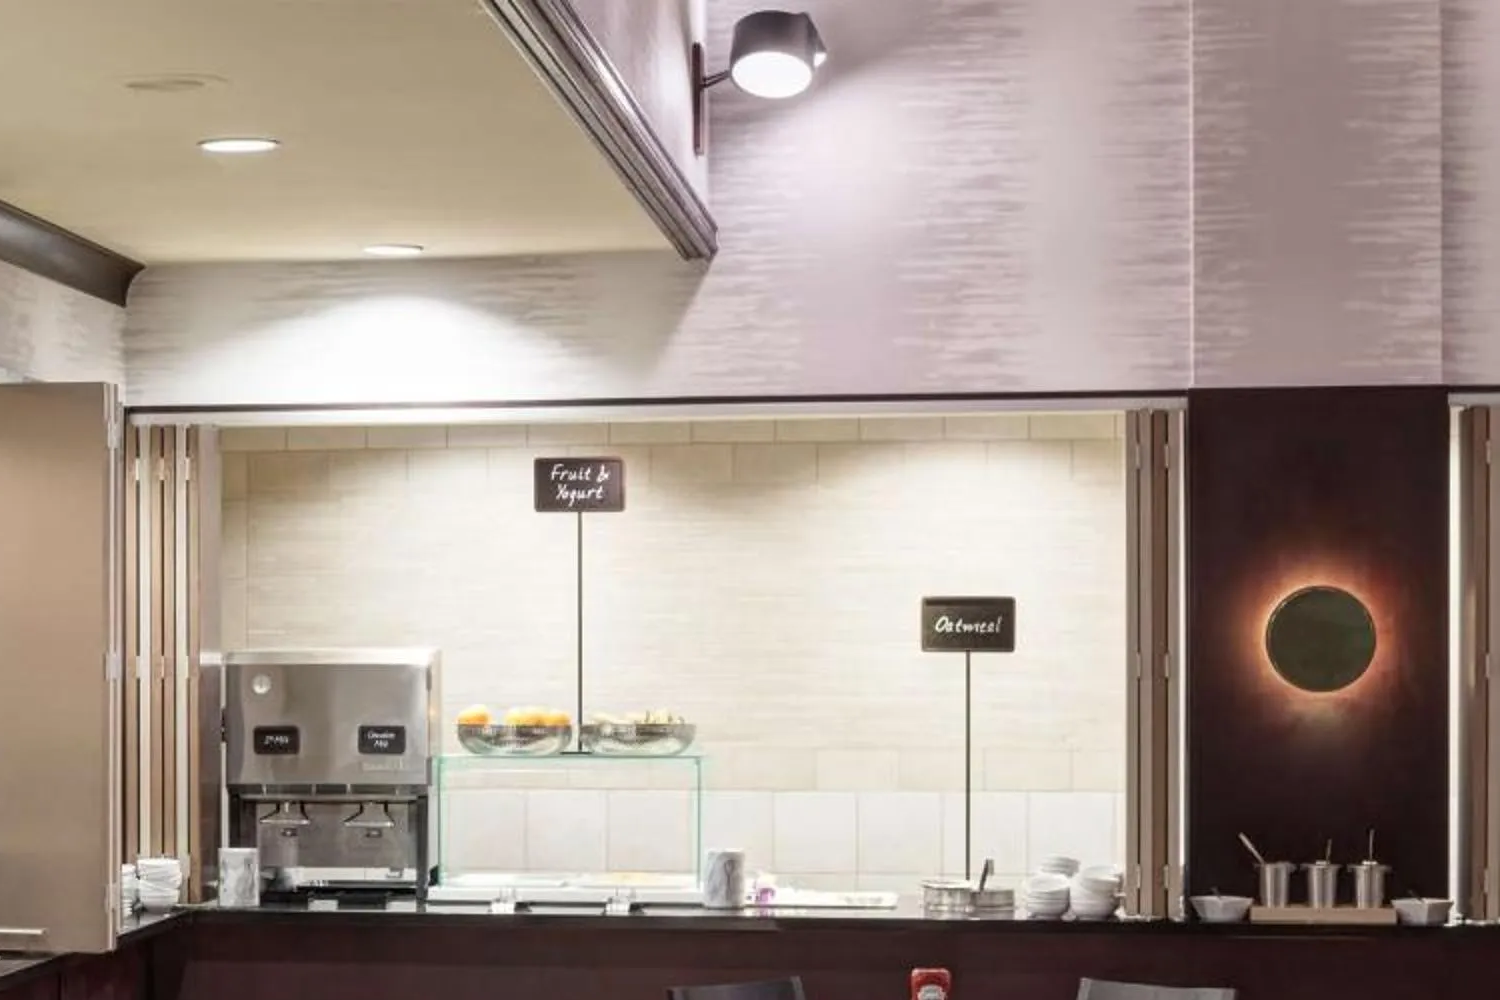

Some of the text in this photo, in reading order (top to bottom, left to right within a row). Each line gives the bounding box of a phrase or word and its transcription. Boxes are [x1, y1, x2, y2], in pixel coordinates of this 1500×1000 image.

[550, 463, 591, 481] Fruit
[556, 484, 603, 507] Yogurt
[935, 615, 1002, 633] Oatmeal
